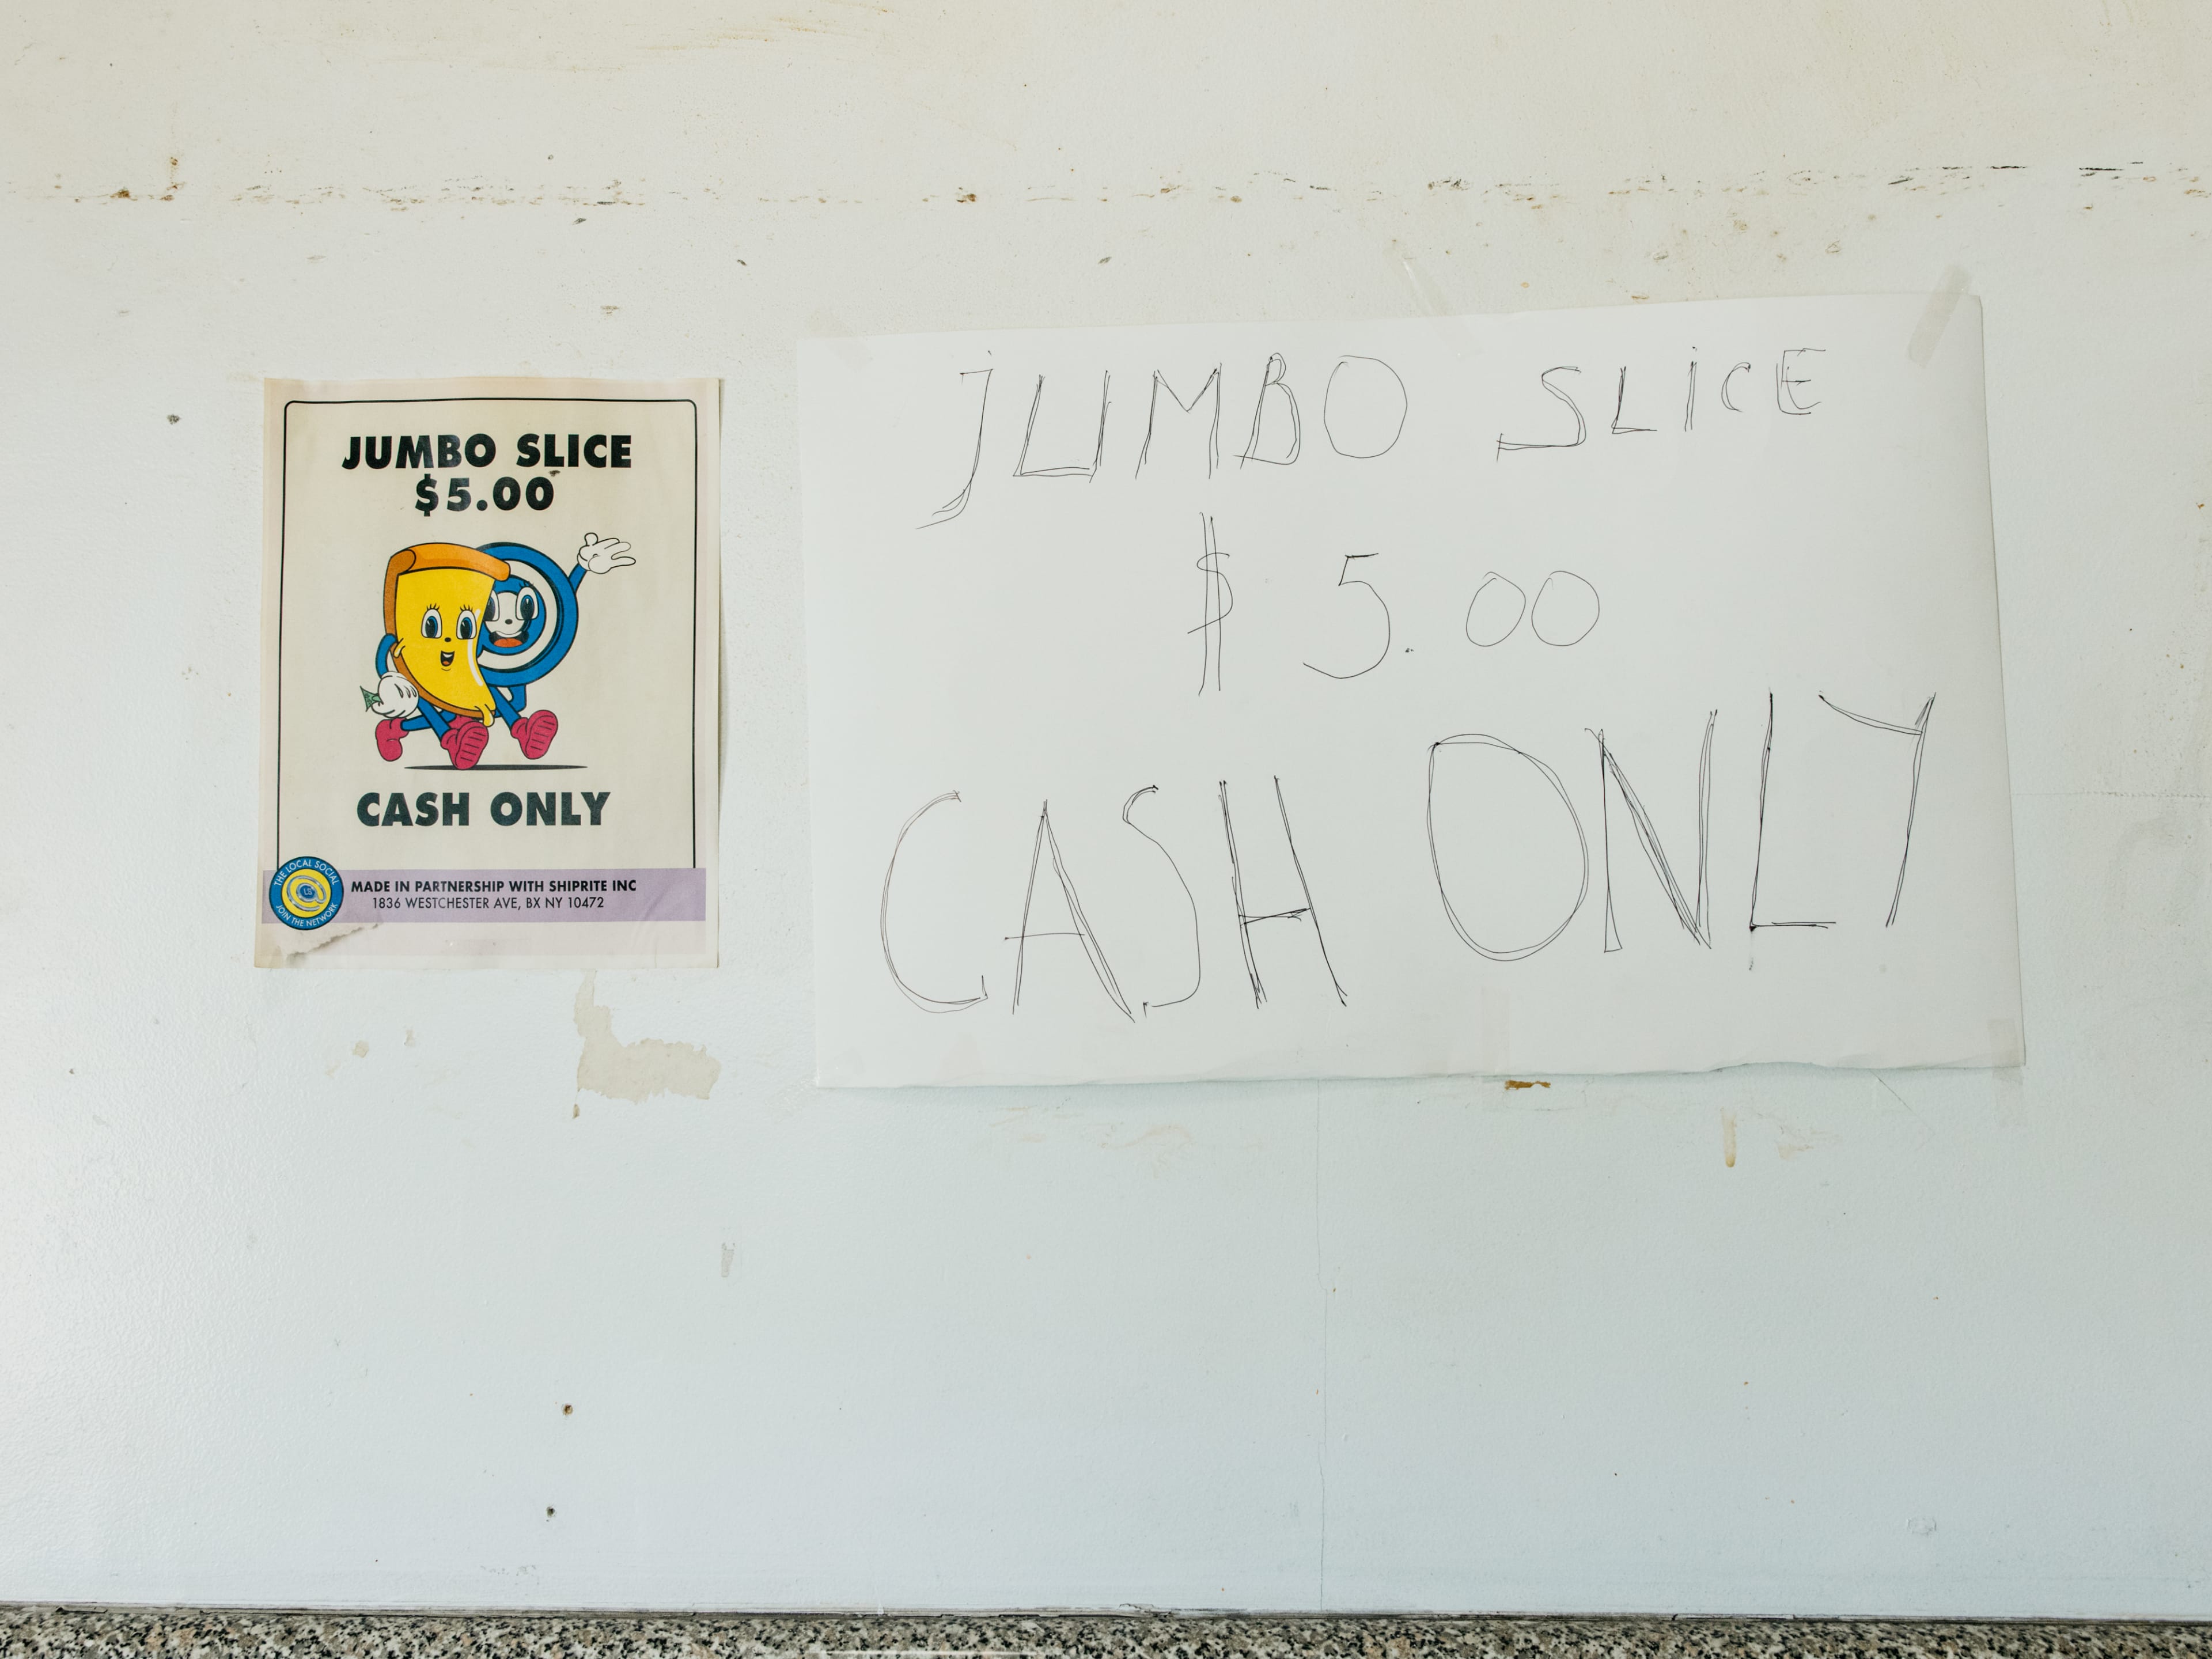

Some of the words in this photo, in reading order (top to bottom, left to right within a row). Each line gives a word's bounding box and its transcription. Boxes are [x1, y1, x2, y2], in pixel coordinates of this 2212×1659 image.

[342, 434, 496, 469] JUMBO
[516, 434, 631, 468] SLICE
[415, 474, 554, 517] $5.00
[357, 792, 469, 826] CASH
[491, 792, 610, 826] ONLY
[881, 775, 1347, 1023] CASH
[1427, 690, 1936, 968] ONLY
[274, 871, 287, 885] THE
[286, 859, 312, 873] LOCAL
[315, 861, 339, 885] SOCIAL
[351, 881, 389, 892] MADE
[396, 881, 409, 892] IN
[416, 881, 504, 892] PARTNERSHIP
[509, 881, 543, 892] WITH
[550, 881, 607, 892] SHIPRITE
[613, 880, 636, 891] INC
[276, 906, 291, 921] JOIN
[291, 918, 304, 926] THE
[306, 903, 338, 926] NETWORK
[373, 897, 400, 908] 1836
[406, 897, 489, 908] WESTCHESTER
[494, 897, 521, 910] AVE,
[527, 897, 540, 908] BX
[546, 897, 562, 908] NY
[569, 897, 604, 908] 10472
